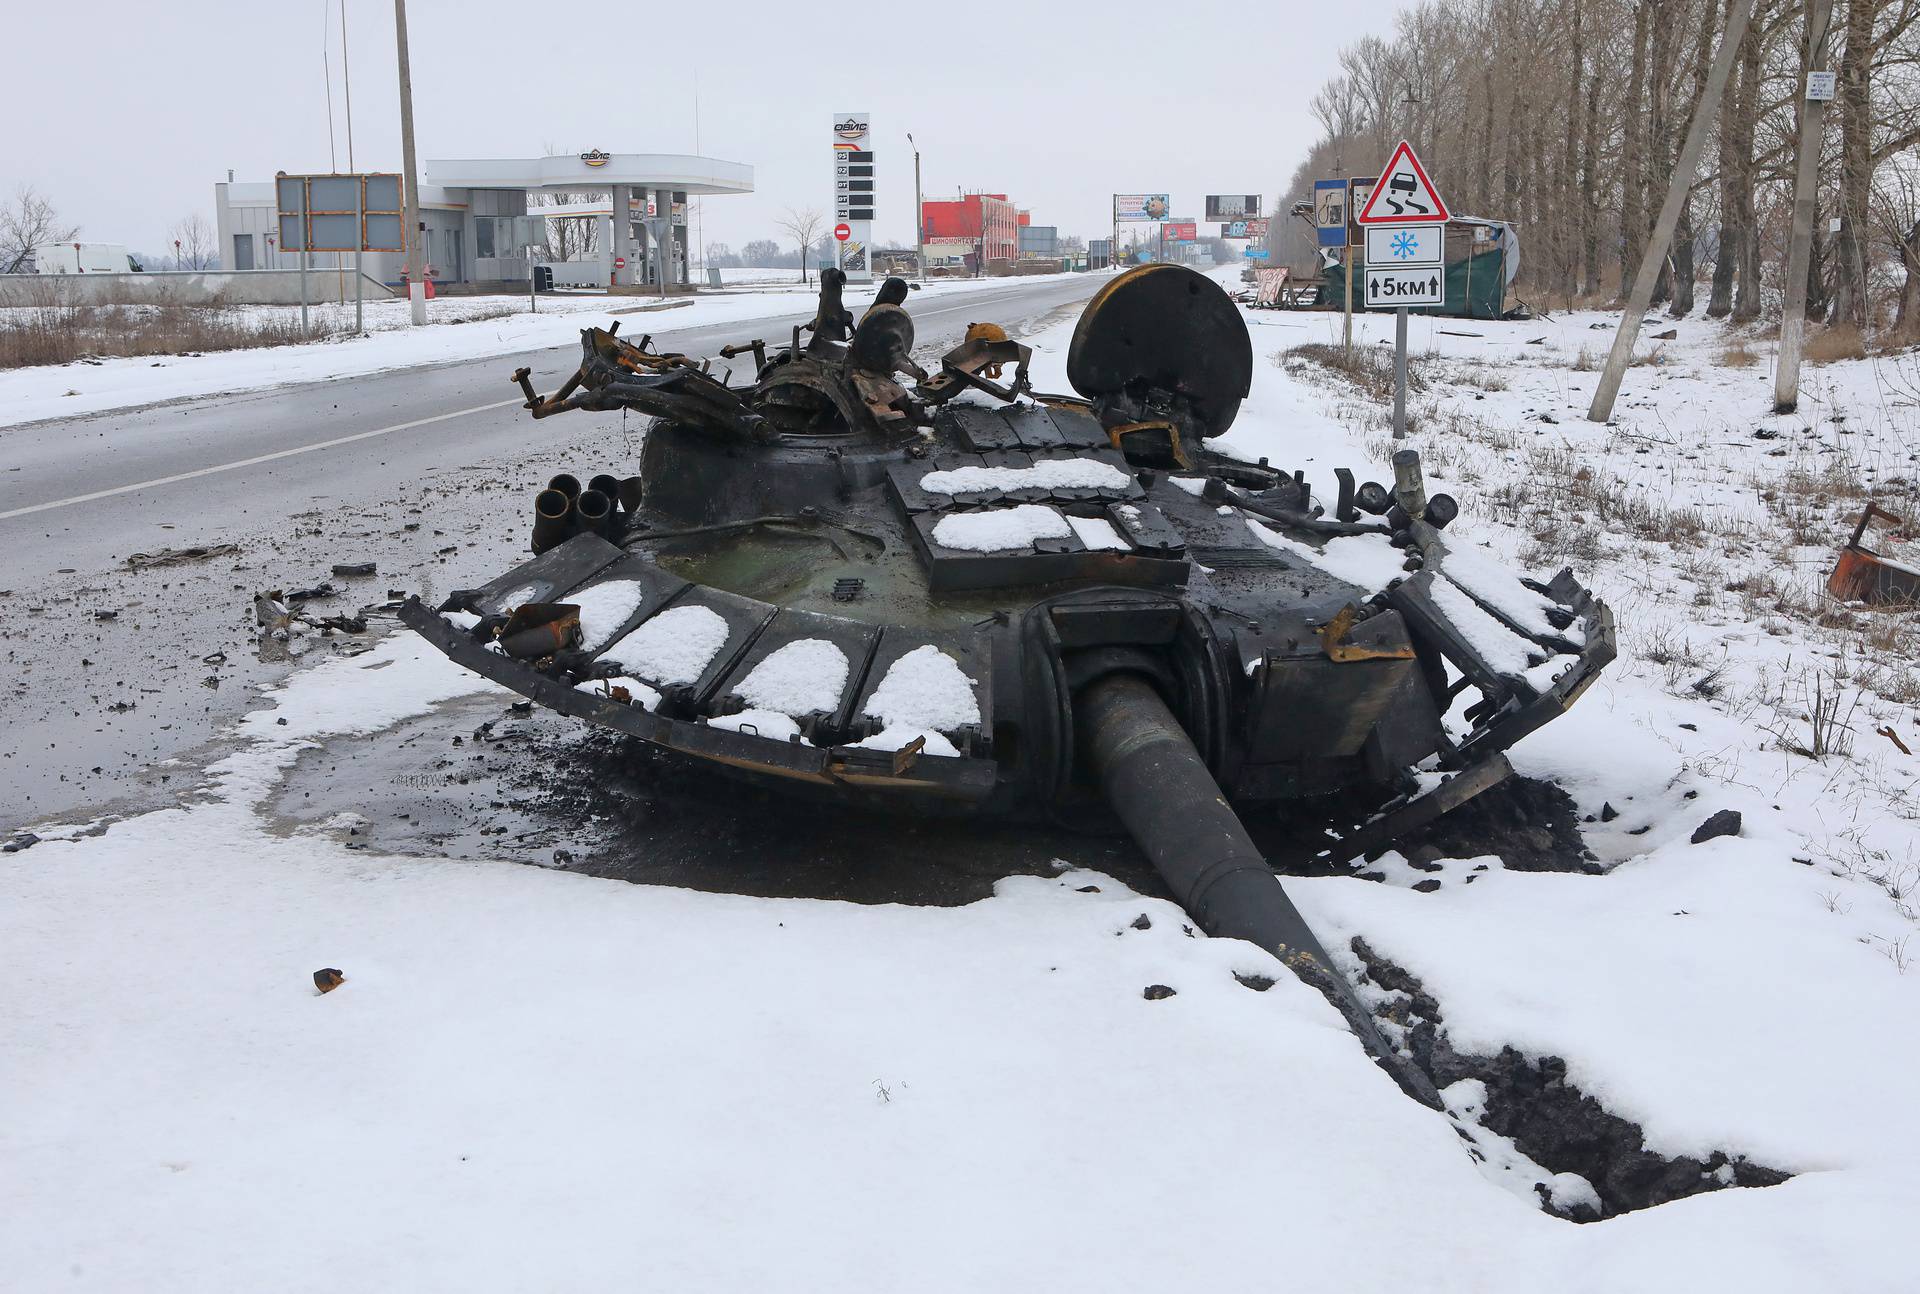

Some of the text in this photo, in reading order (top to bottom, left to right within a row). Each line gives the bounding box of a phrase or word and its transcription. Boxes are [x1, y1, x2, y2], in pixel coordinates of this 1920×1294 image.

[834, 123, 867, 131] ОВИС
[581, 152, 611, 160] ОВИС
[1383, 277, 1425, 296] 5км
